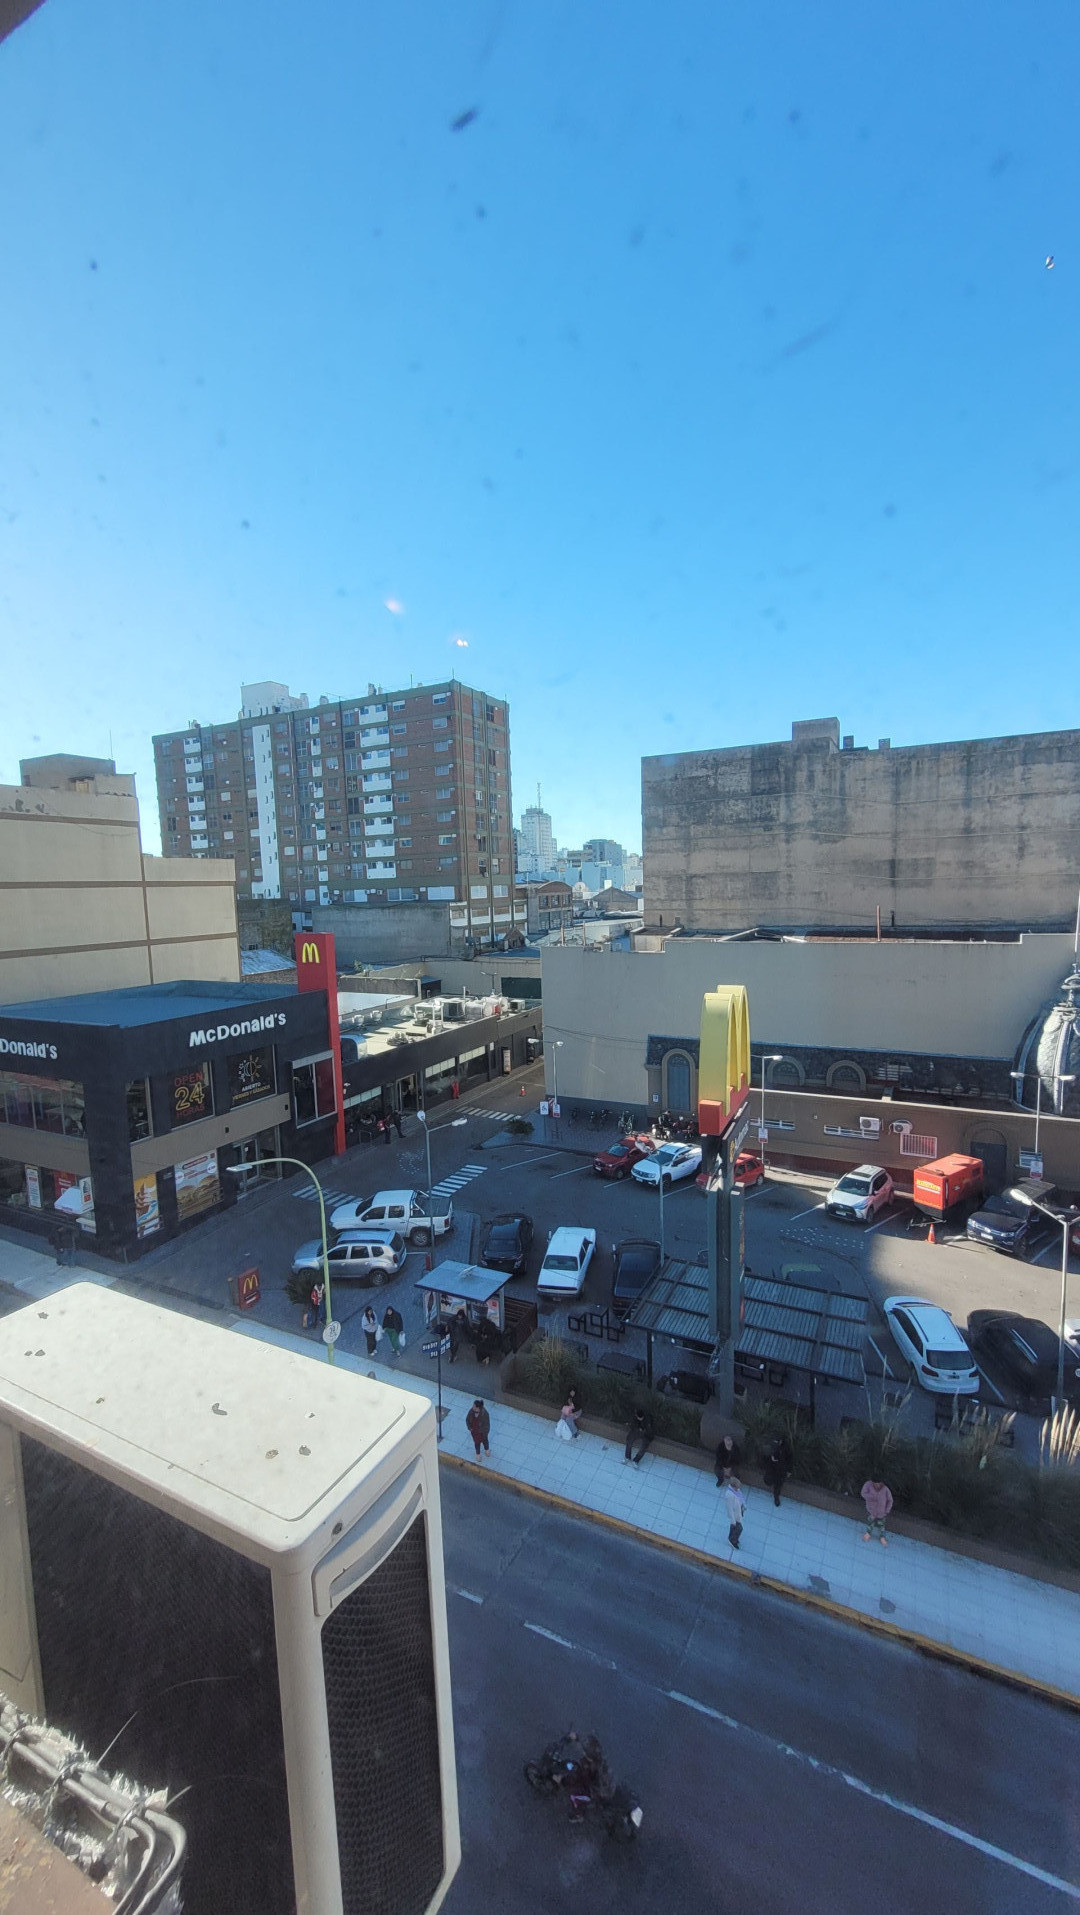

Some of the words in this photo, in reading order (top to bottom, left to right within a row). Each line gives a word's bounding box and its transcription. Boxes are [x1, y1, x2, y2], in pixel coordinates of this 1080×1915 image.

[189, 1013, 287, 1047] McDonald's
[0, 1038, 58, 1060] Donald's
[175, 1073, 204, 1086] OPEN
[242, 1082, 261, 1092] ABIERTO
[174, 1082, 205, 1111] 24
[176, 1104, 205, 1118] HORAS
